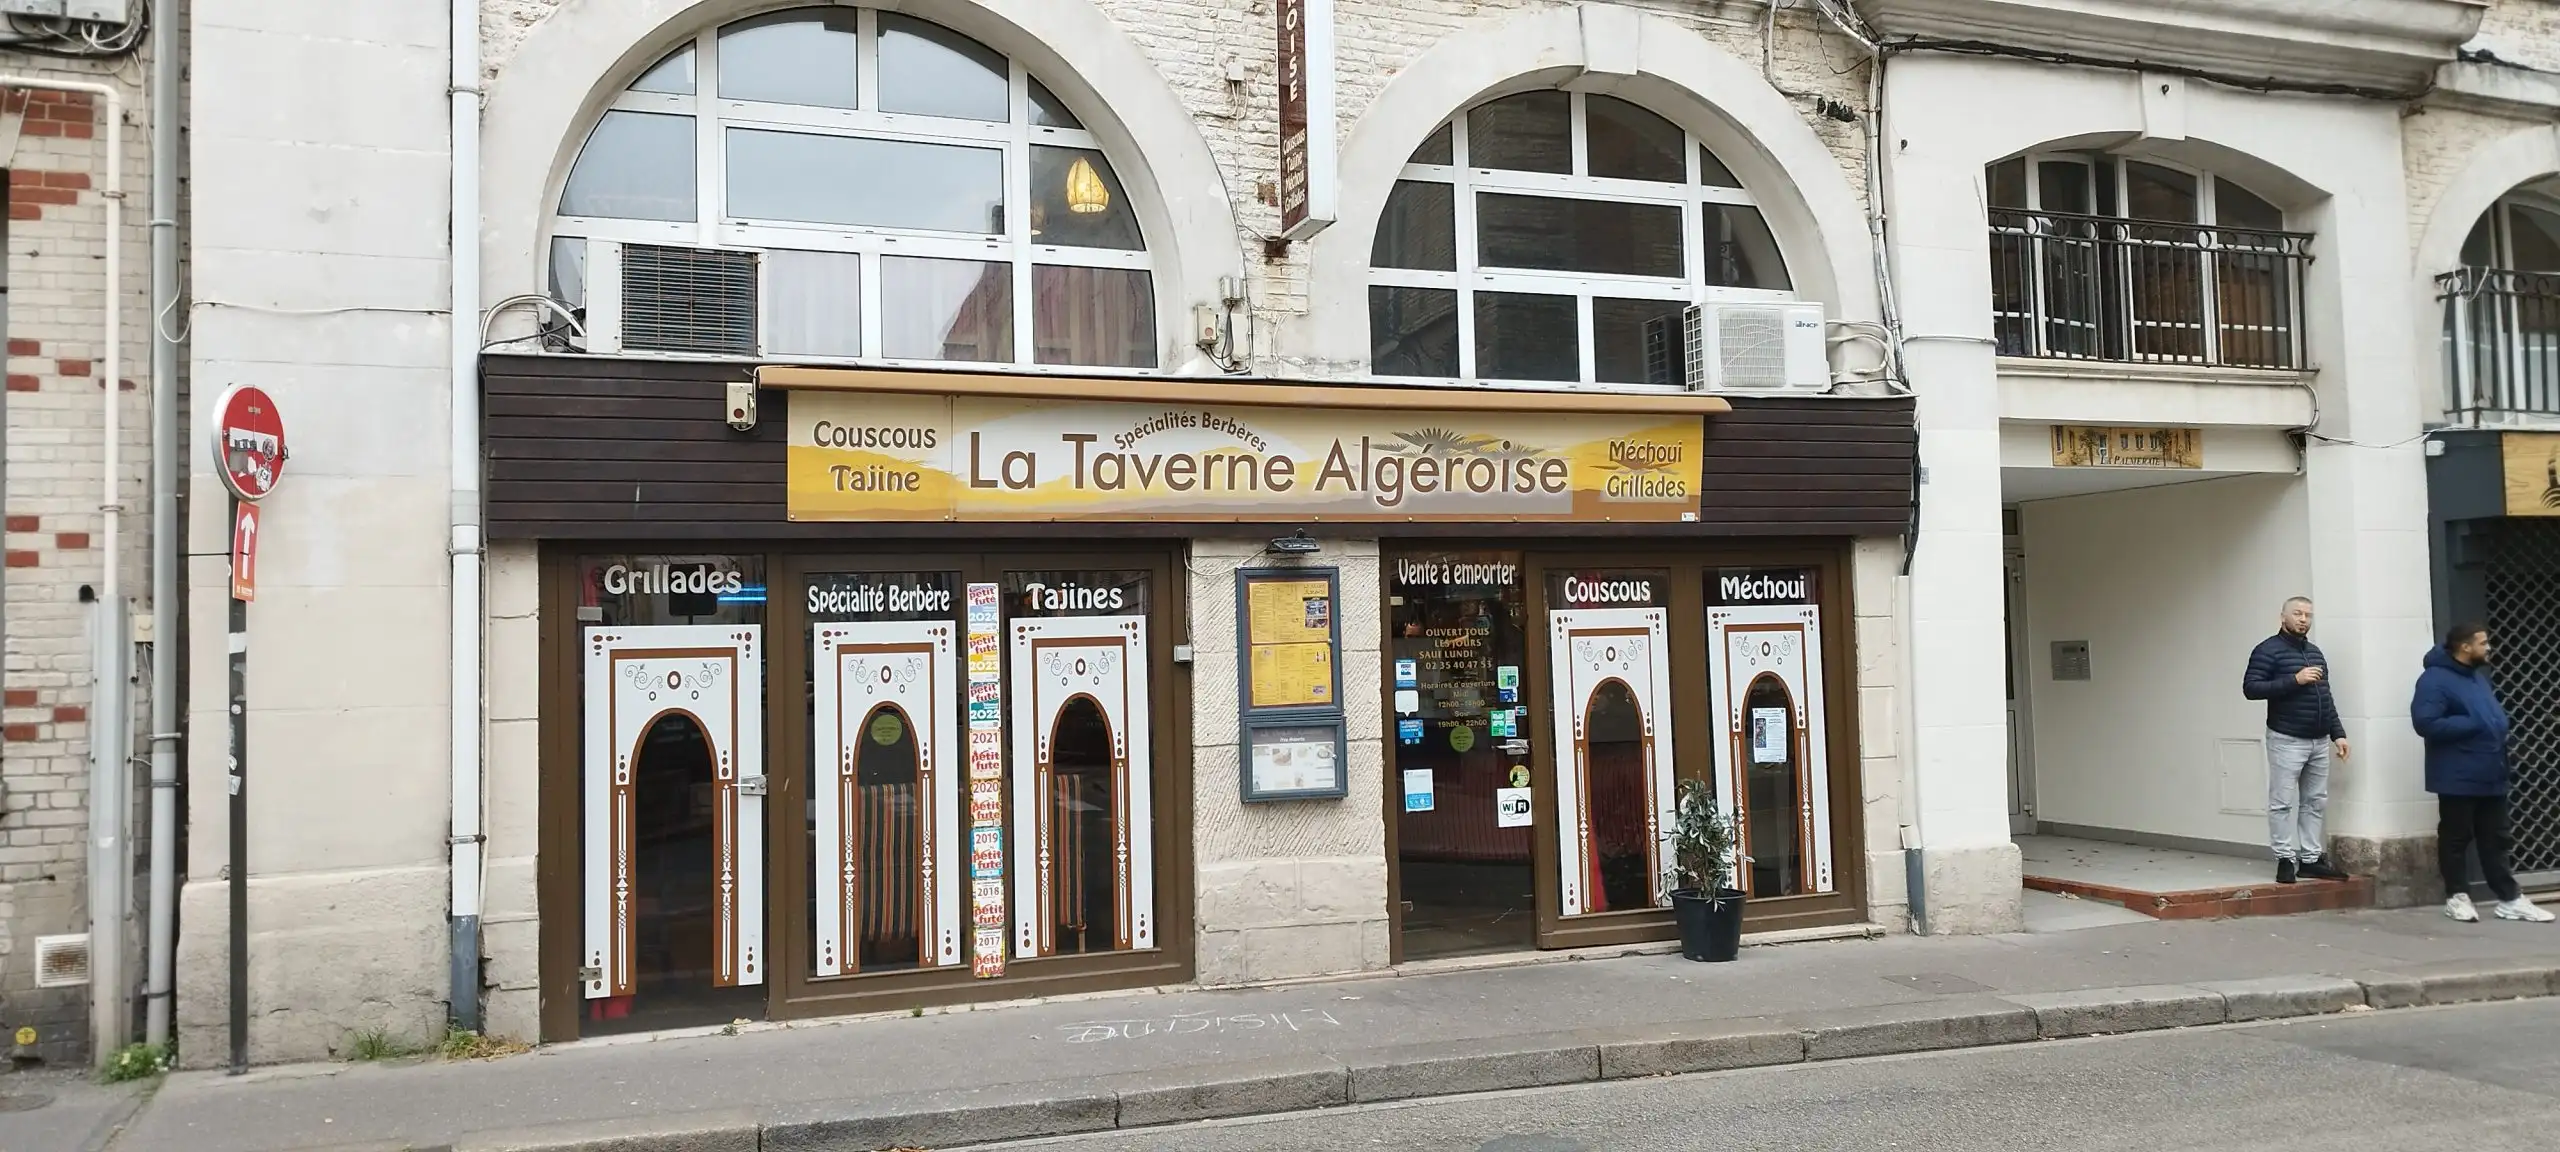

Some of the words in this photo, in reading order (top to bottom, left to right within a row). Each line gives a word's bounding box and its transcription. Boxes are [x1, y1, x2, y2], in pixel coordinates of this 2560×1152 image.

[1286, 0, 1299, 102] OISE
[1283, 128, 1306, 155] Couscous
[813, 420, 937, 449] Couscous
[1114, 411, 1197, 451] Spécialités
[1201, 411, 1268, 454] Berbères
[1608, 439, 1683, 463] Méchoui
[969, 431, 1037, 490] La
[1062, 433, 1295, 492] Taverne
[1315, 436, 1568, 507] Algéroise
[830, 465, 921, 493] Tajine
[1606, 474, 1686, 499] Grillades
[603, 564, 742, 595] Grillades
[1398, 558, 1438, 586] Vente
[1442, 557, 1451, 586] à
[1453, 561, 1517, 586] emporter
[969, 587, 995, 600] petit
[1025, 582, 1124, 611] Tajines
[1564, 576, 1651, 604] Couscous
[1720, 574, 1806, 601] Méchoui
[807, 583, 885, 615] Spécialité
[889, 583, 950, 613] Berbère
[969, 612, 997, 622] 2024
[1425, 628, 1463, 637] OUVERT
[1464, 627, 1490, 636] TOUS
[1434, 639, 1449, 648] LES
[1444, 650, 1473, 659] LUNDI
[1425, 661, 1437, 670] 02
[1439, 661, 1451, 670] 35
[1453, 660, 1465, 669] 40
[1466, 660, 1478, 669] 47
[970, 683, 997, 698] petit
[1420, 681, 1452, 690] Horaires
[970, 709, 999, 720] 2022
[972, 732, 998, 744] 2021
[973, 781, 999, 793] 2020
[975, 832, 999, 844] 2019
[977, 887, 1000, 897] 2018
[979, 937, 1001, 946] 2017
